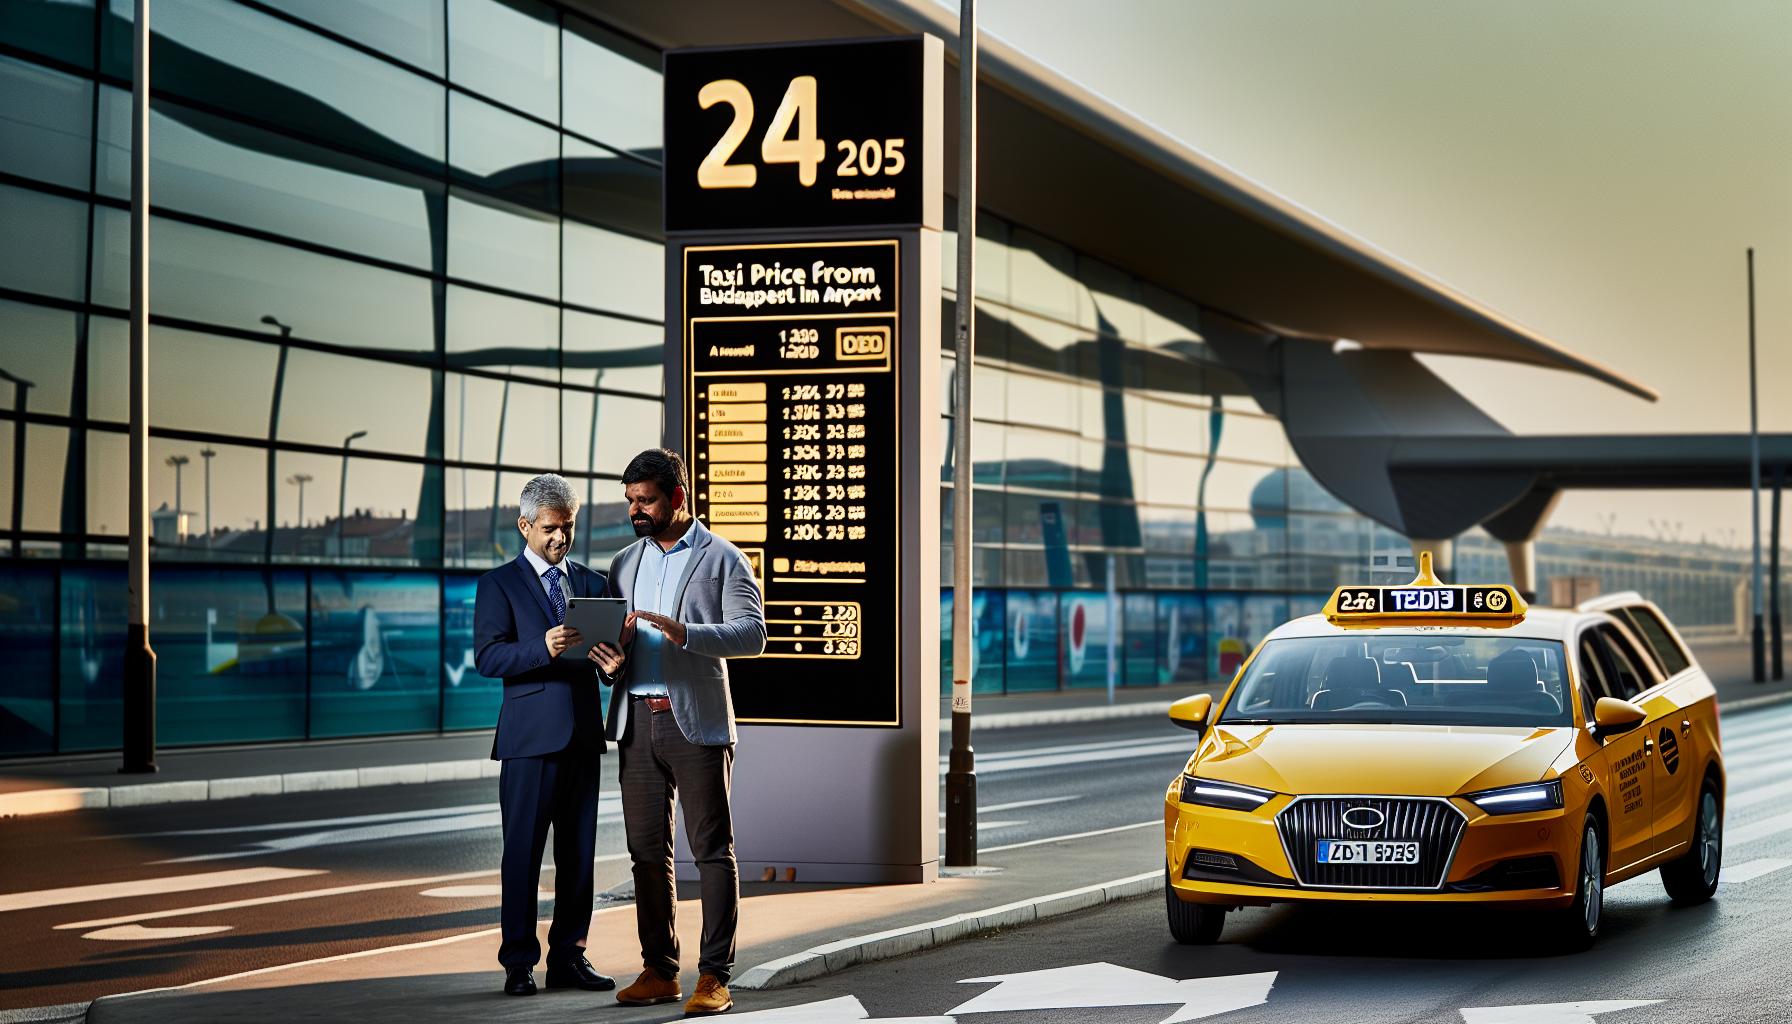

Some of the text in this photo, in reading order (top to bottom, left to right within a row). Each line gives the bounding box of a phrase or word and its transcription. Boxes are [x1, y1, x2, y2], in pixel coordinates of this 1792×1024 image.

[697, 75, 826, 189] 24
[836, 138, 906, 177] 205
[699, 260, 876, 286] Taxi Price From
